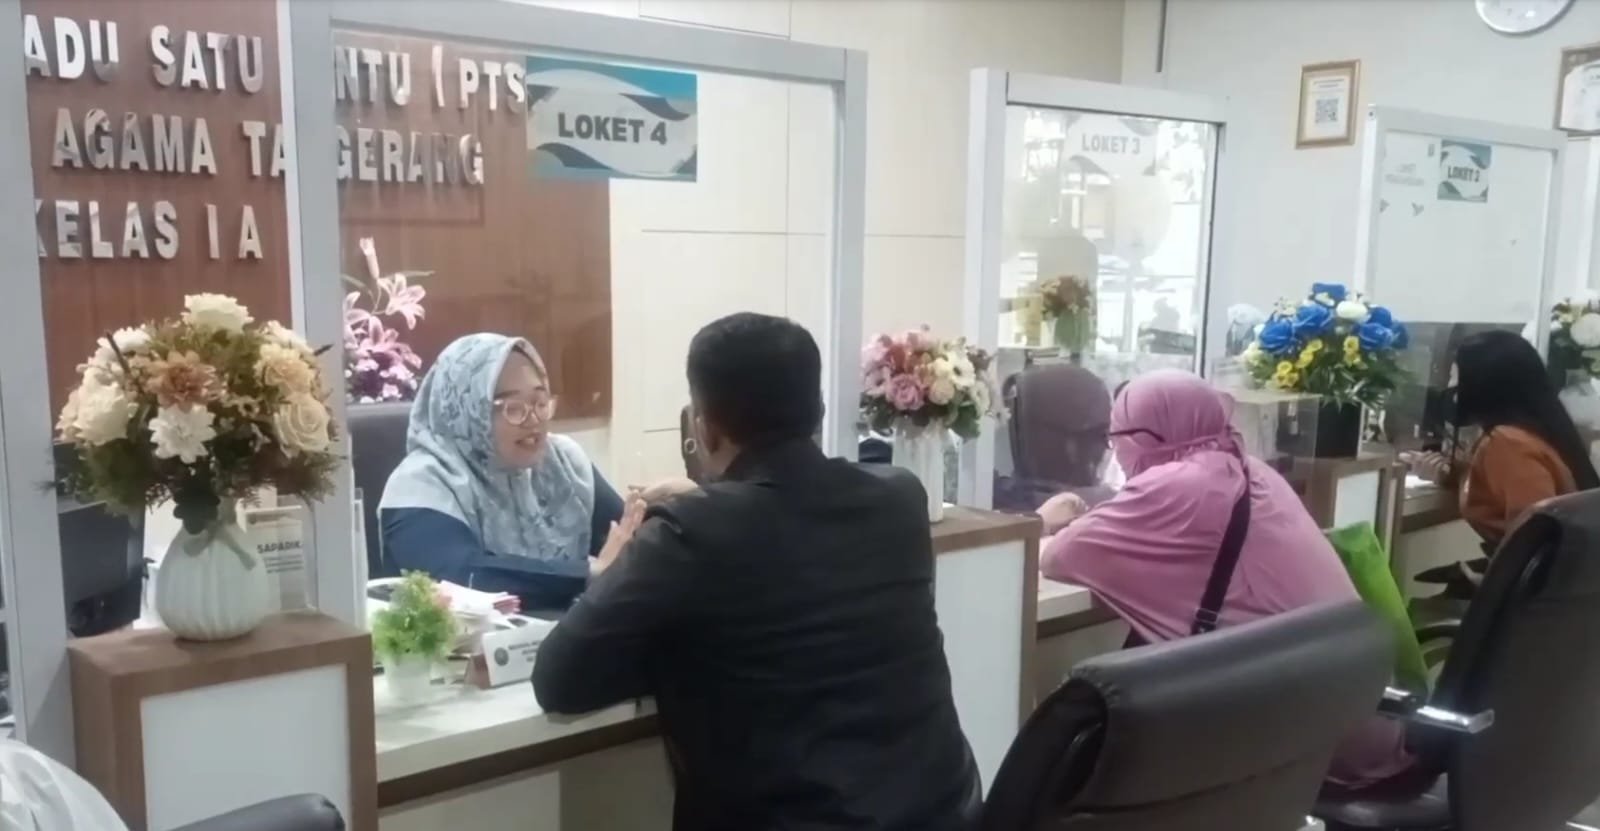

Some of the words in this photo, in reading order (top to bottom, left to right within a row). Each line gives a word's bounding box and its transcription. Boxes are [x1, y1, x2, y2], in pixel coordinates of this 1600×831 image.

[24, 14, 119, 82] ADU
[150, 25, 264, 94] SATU
[334, 44, 411, 106] NTU
[51, 107, 218, 175] AGAMA
[241, 119, 485, 185] TAGERANG
[558, 111, 645, 143] LOKET
[650, 121, 668, 146] 4
[1081, 132, 1129, 154] LOKET
[205, 202, 221, 260] I
[238, 204, 264, 260] A
